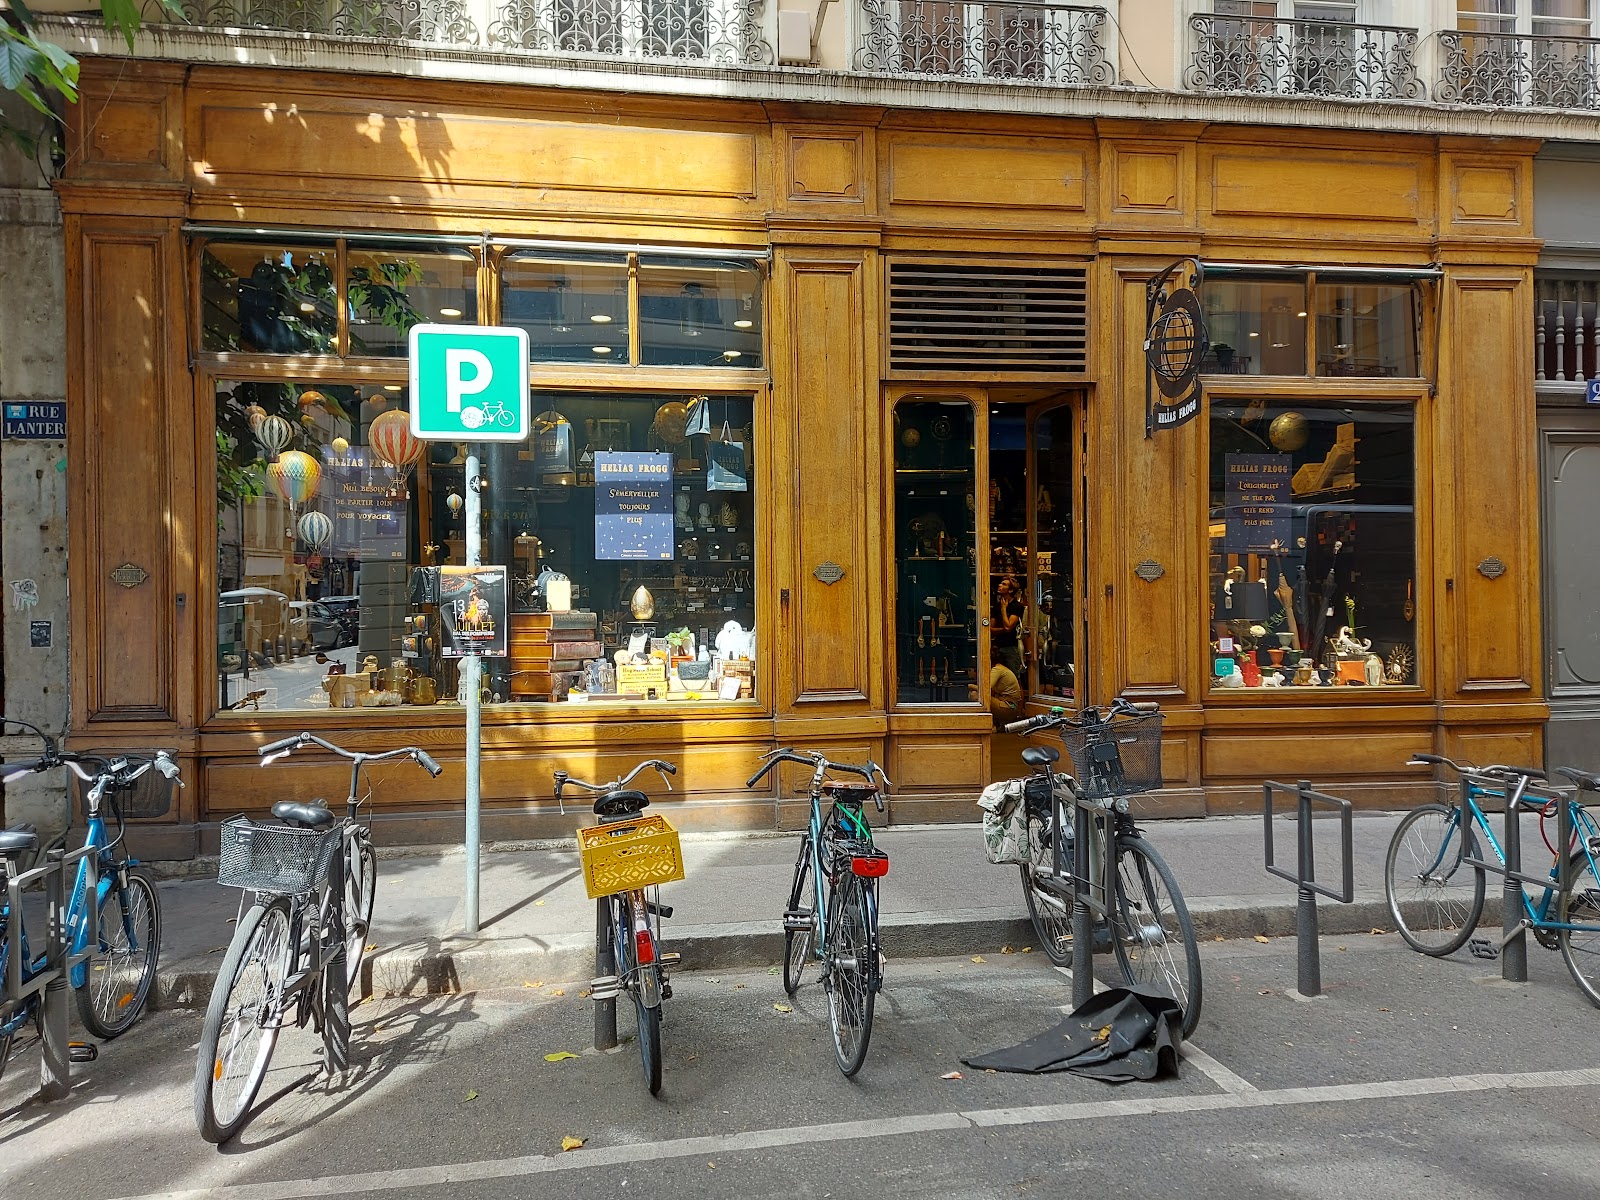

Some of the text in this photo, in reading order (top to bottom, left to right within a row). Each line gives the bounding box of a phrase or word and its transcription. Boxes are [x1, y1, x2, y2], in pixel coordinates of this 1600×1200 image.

[446, 348, 494, 413] P
[29, 405, 60, 418] RUE
[1157, 399, 1198, 424] HELIAS FROGG
[6, 422, 66, 435] LANTER
[328, 458, 364, 467] HELIAS
[600, 463, 668, 473] HELIAS FROGG
[1230, 464, 1288, 473] HELIAS FROGG
[336, 512, 392, 521] POUR VOYAGER
[626, 516, 643, 524] PLUS
[452, 600, 465, 611] 13
[453, 622, 495, 632] JUILLET
